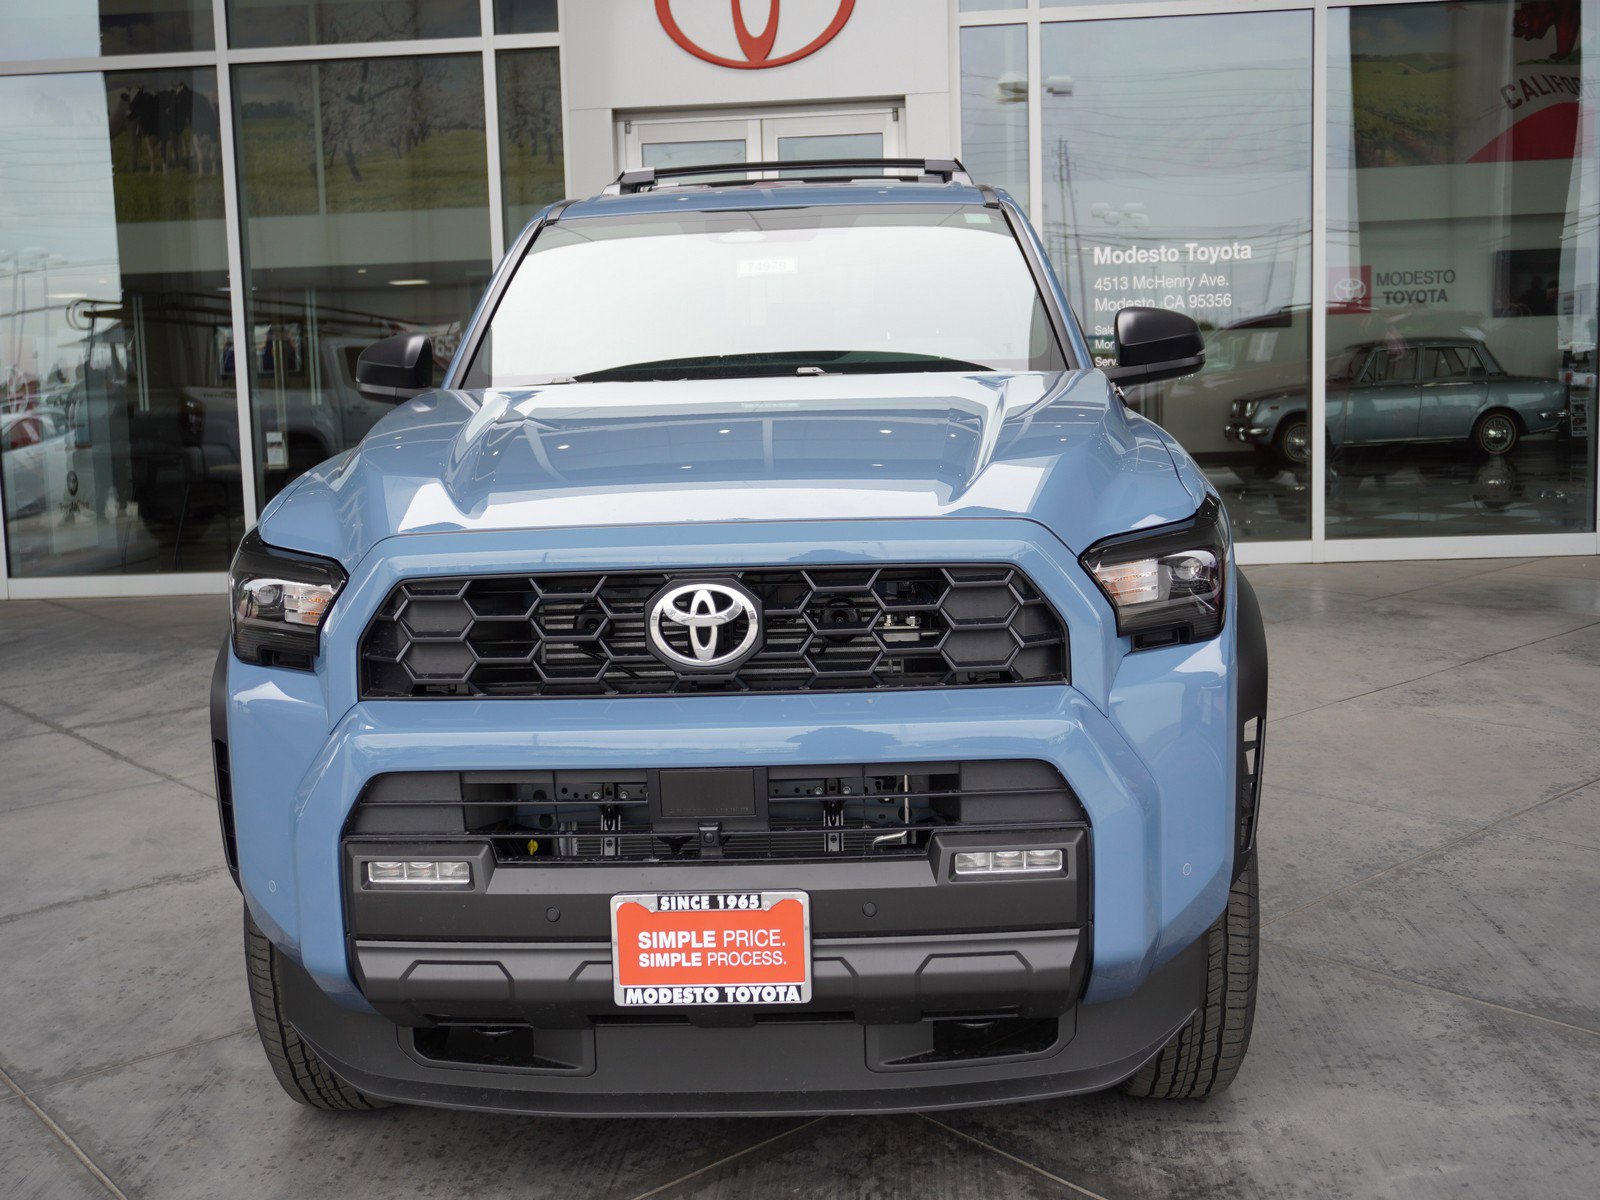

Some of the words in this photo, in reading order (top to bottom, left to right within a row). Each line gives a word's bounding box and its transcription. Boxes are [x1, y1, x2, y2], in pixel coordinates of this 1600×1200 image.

[1094, 245, 1180, 265] Modesto
[1185, 242, 1252, 264] Toyota
[1094, 277, 1128, 291] 4513
[1133, 274, 1195, 291] McHenry
[1199, 274, 1229, 287] Ave.
[1376, 269, 1456, 287] MODESTO
[1163, 295, 1186, 309] CA
[1189, 293, 1232, 308] 95356
[1383, 289, 1449, 305] TOYOTA
[1095, 325, 1115, 335] Sale
[660, 896, 710, 910] SINCE
[717, 895, 760, 909] 1965
[638, 930, 716, 949] SIMPLE
[723, 929, 786, 947] PRICE.
[638, 952, 702, 967] SIMPLE
[707, 951, 787, 966] PROCESS.
[626, 987, 720, 1004] MODESTO
[725, 985, 801, 1003] TOYOTA
